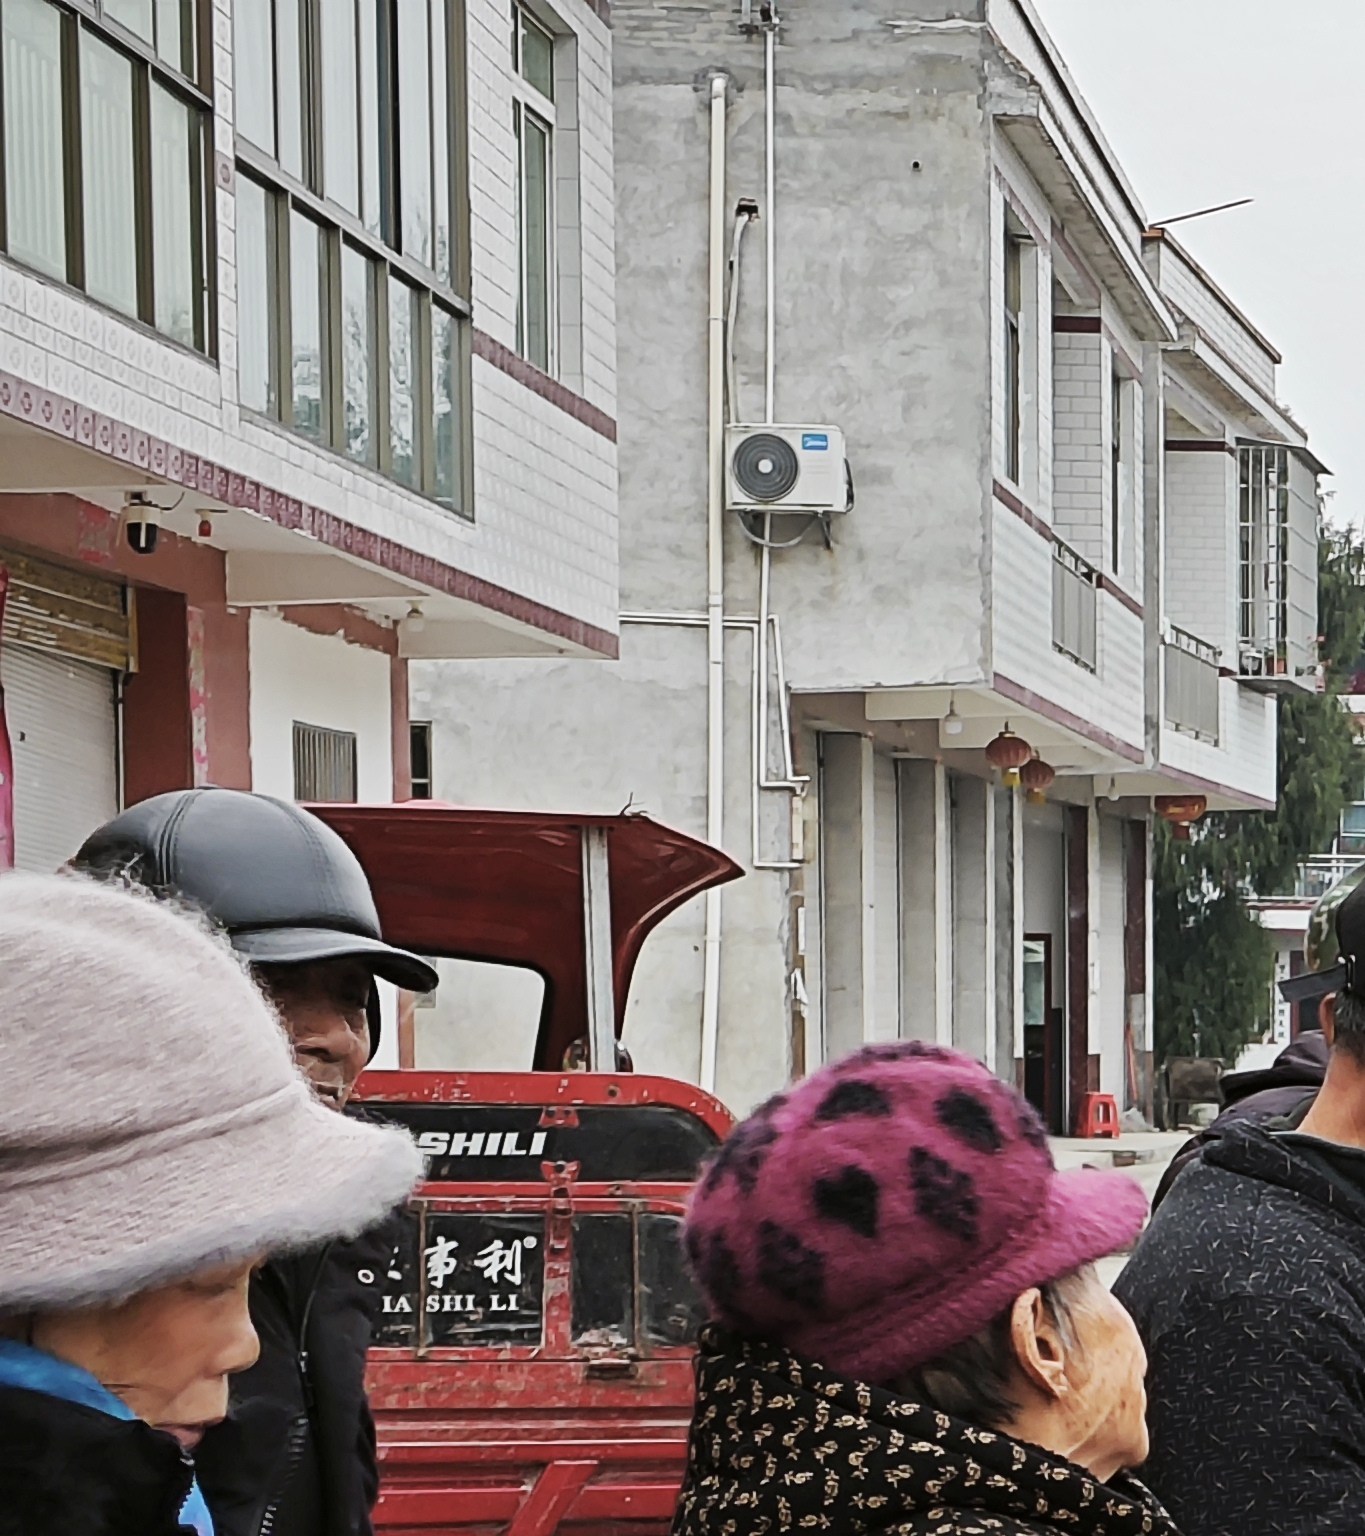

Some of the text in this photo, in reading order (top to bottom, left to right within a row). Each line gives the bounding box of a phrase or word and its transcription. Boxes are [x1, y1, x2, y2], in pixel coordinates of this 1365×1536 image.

[416, 1132, 547, 1155] SHILI
[426, 1294, 476, 1312] SHI
[489, 1294, 520, 1312] LI
